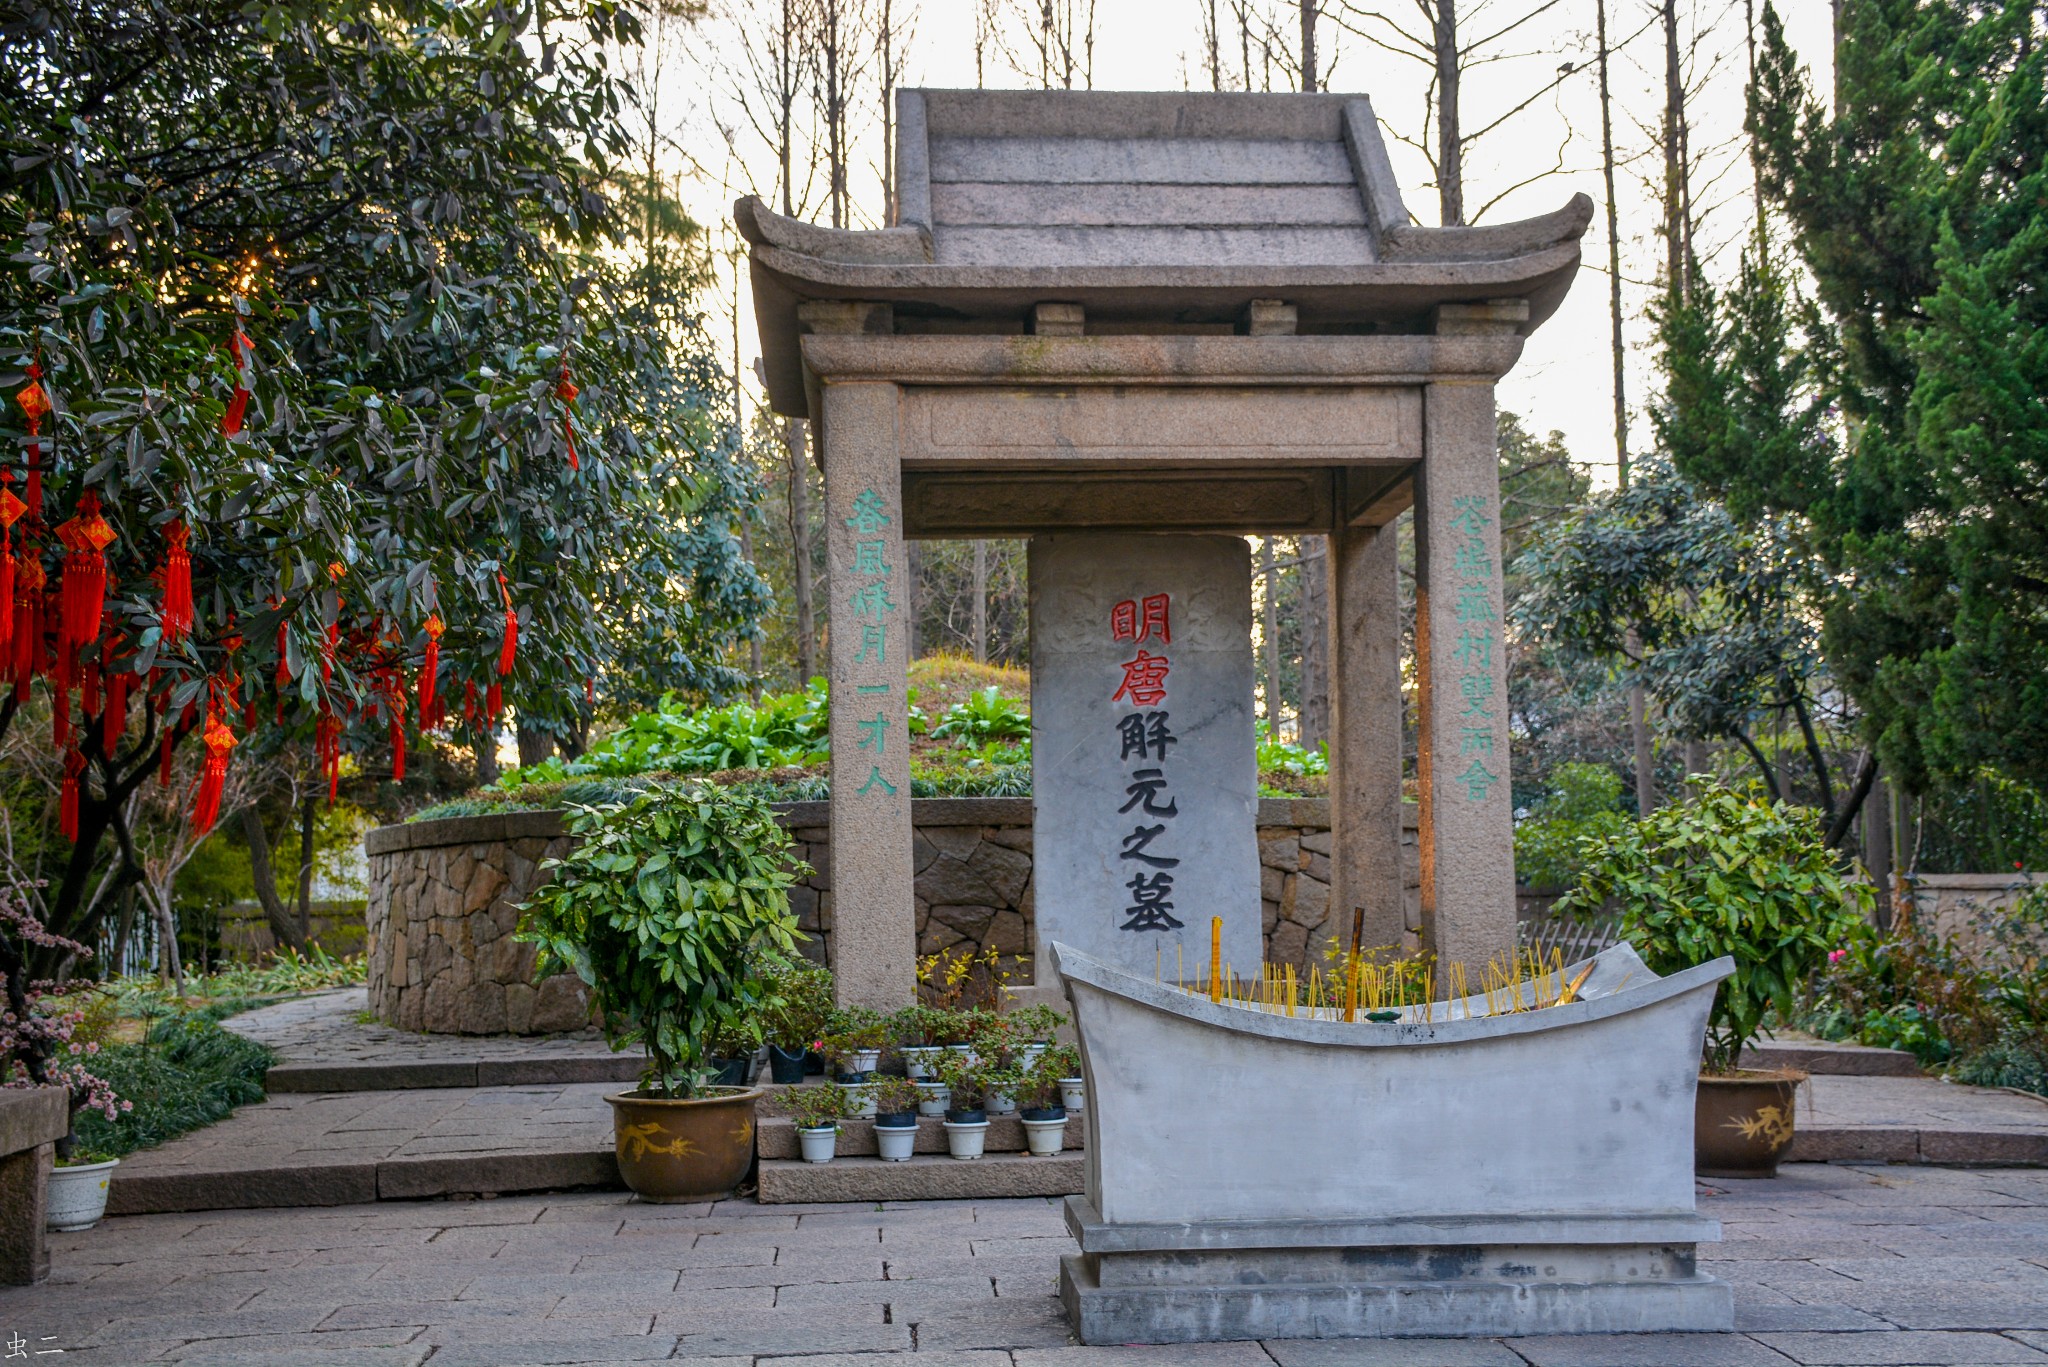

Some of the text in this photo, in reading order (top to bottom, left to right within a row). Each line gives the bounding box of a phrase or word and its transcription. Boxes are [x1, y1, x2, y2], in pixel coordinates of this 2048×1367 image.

[1110, 592, 1185, 932] 明唐解元之墓
